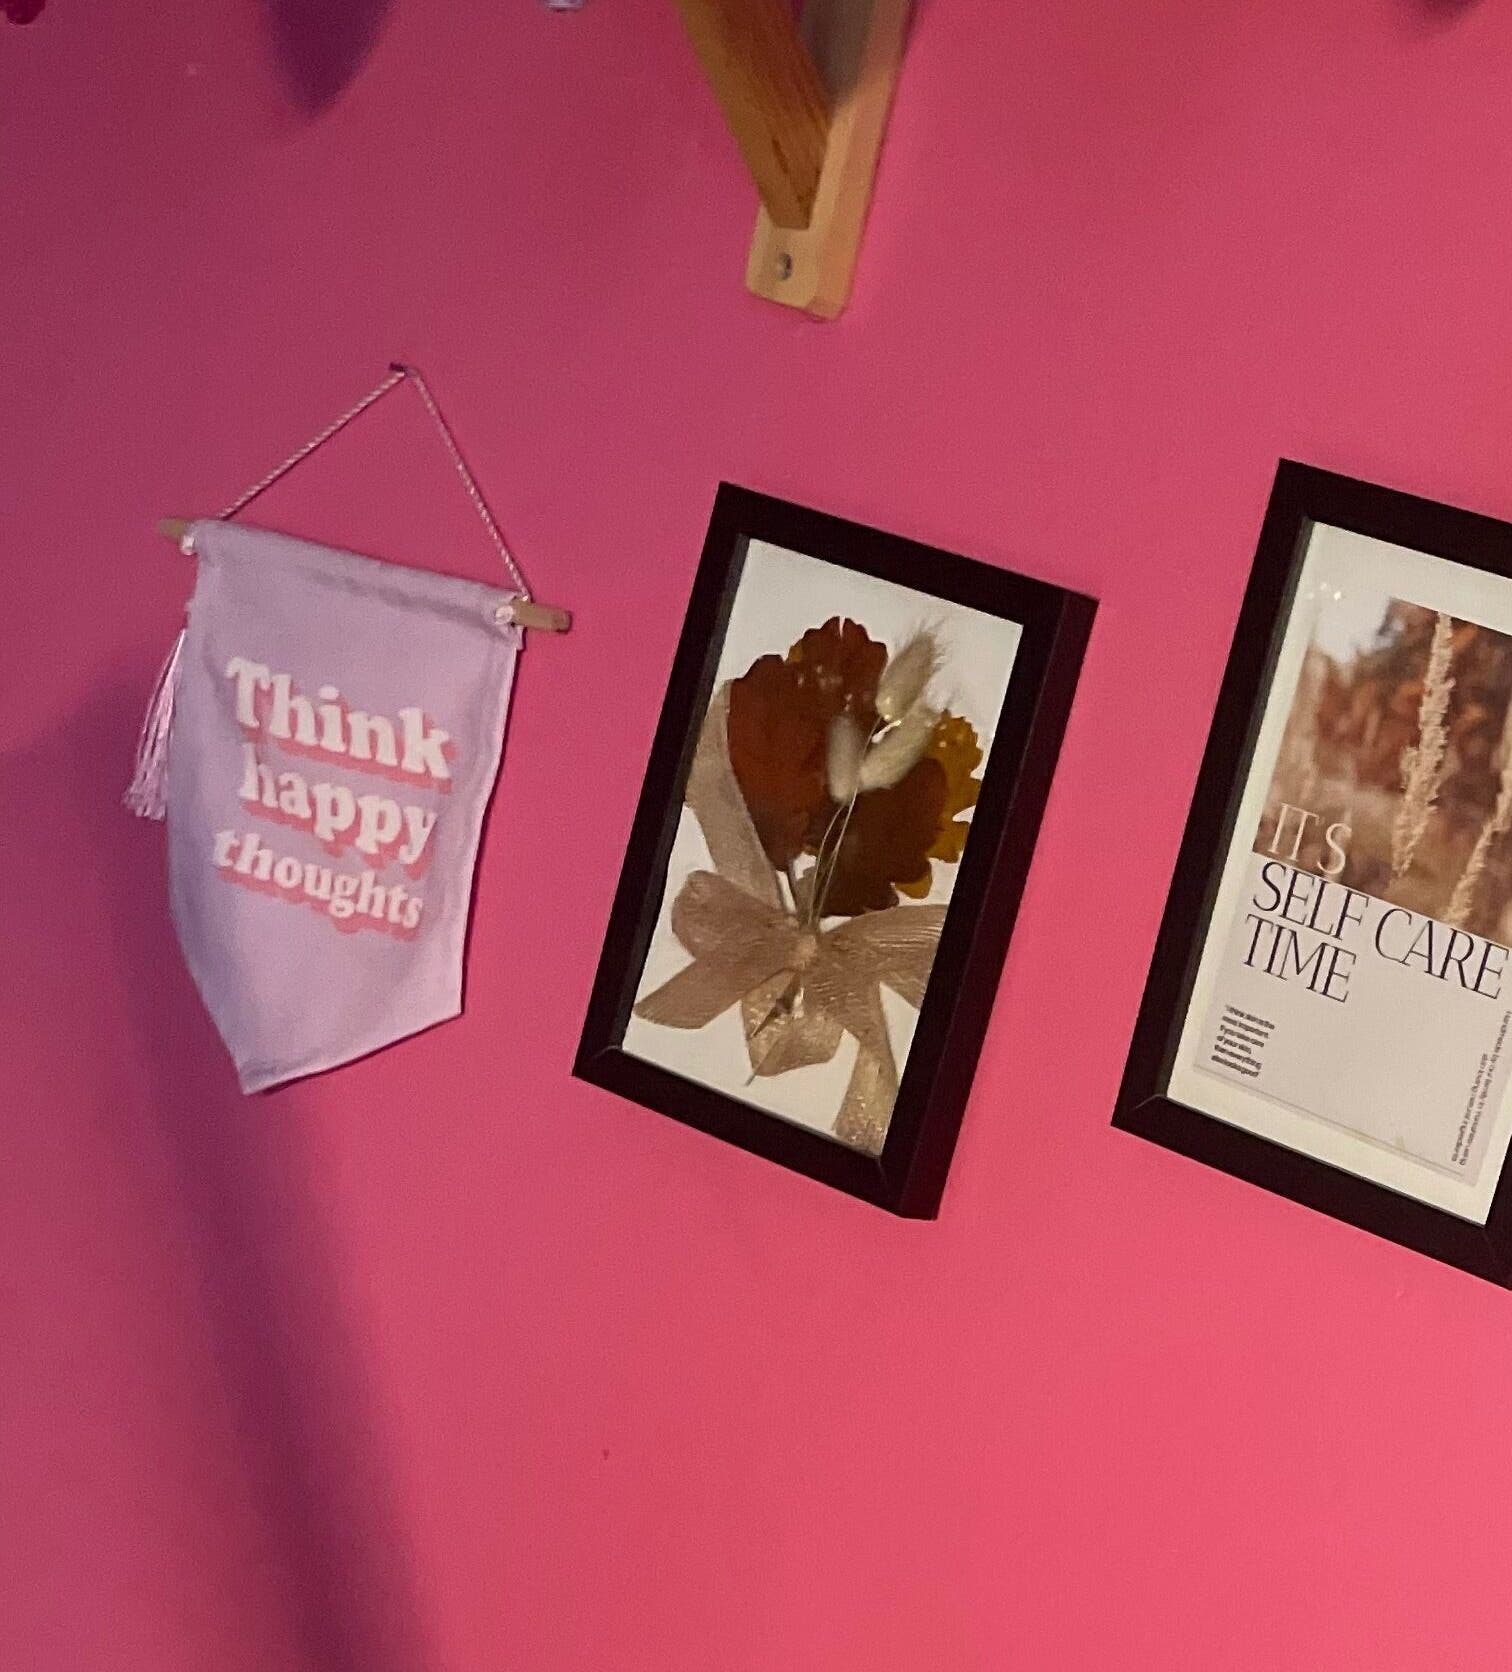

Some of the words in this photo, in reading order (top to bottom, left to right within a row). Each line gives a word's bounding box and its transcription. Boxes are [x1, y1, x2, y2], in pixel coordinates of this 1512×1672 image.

[225, 656, 454, 783] Think
[237, 742, 439, 866] happy
[212, 829, 424, 931] thoughts
[1252, 861, 1370, 941] SELF
[1374, 907, 1510, 1000] CARE
[1243, 913, 1357, 1003] TIME
